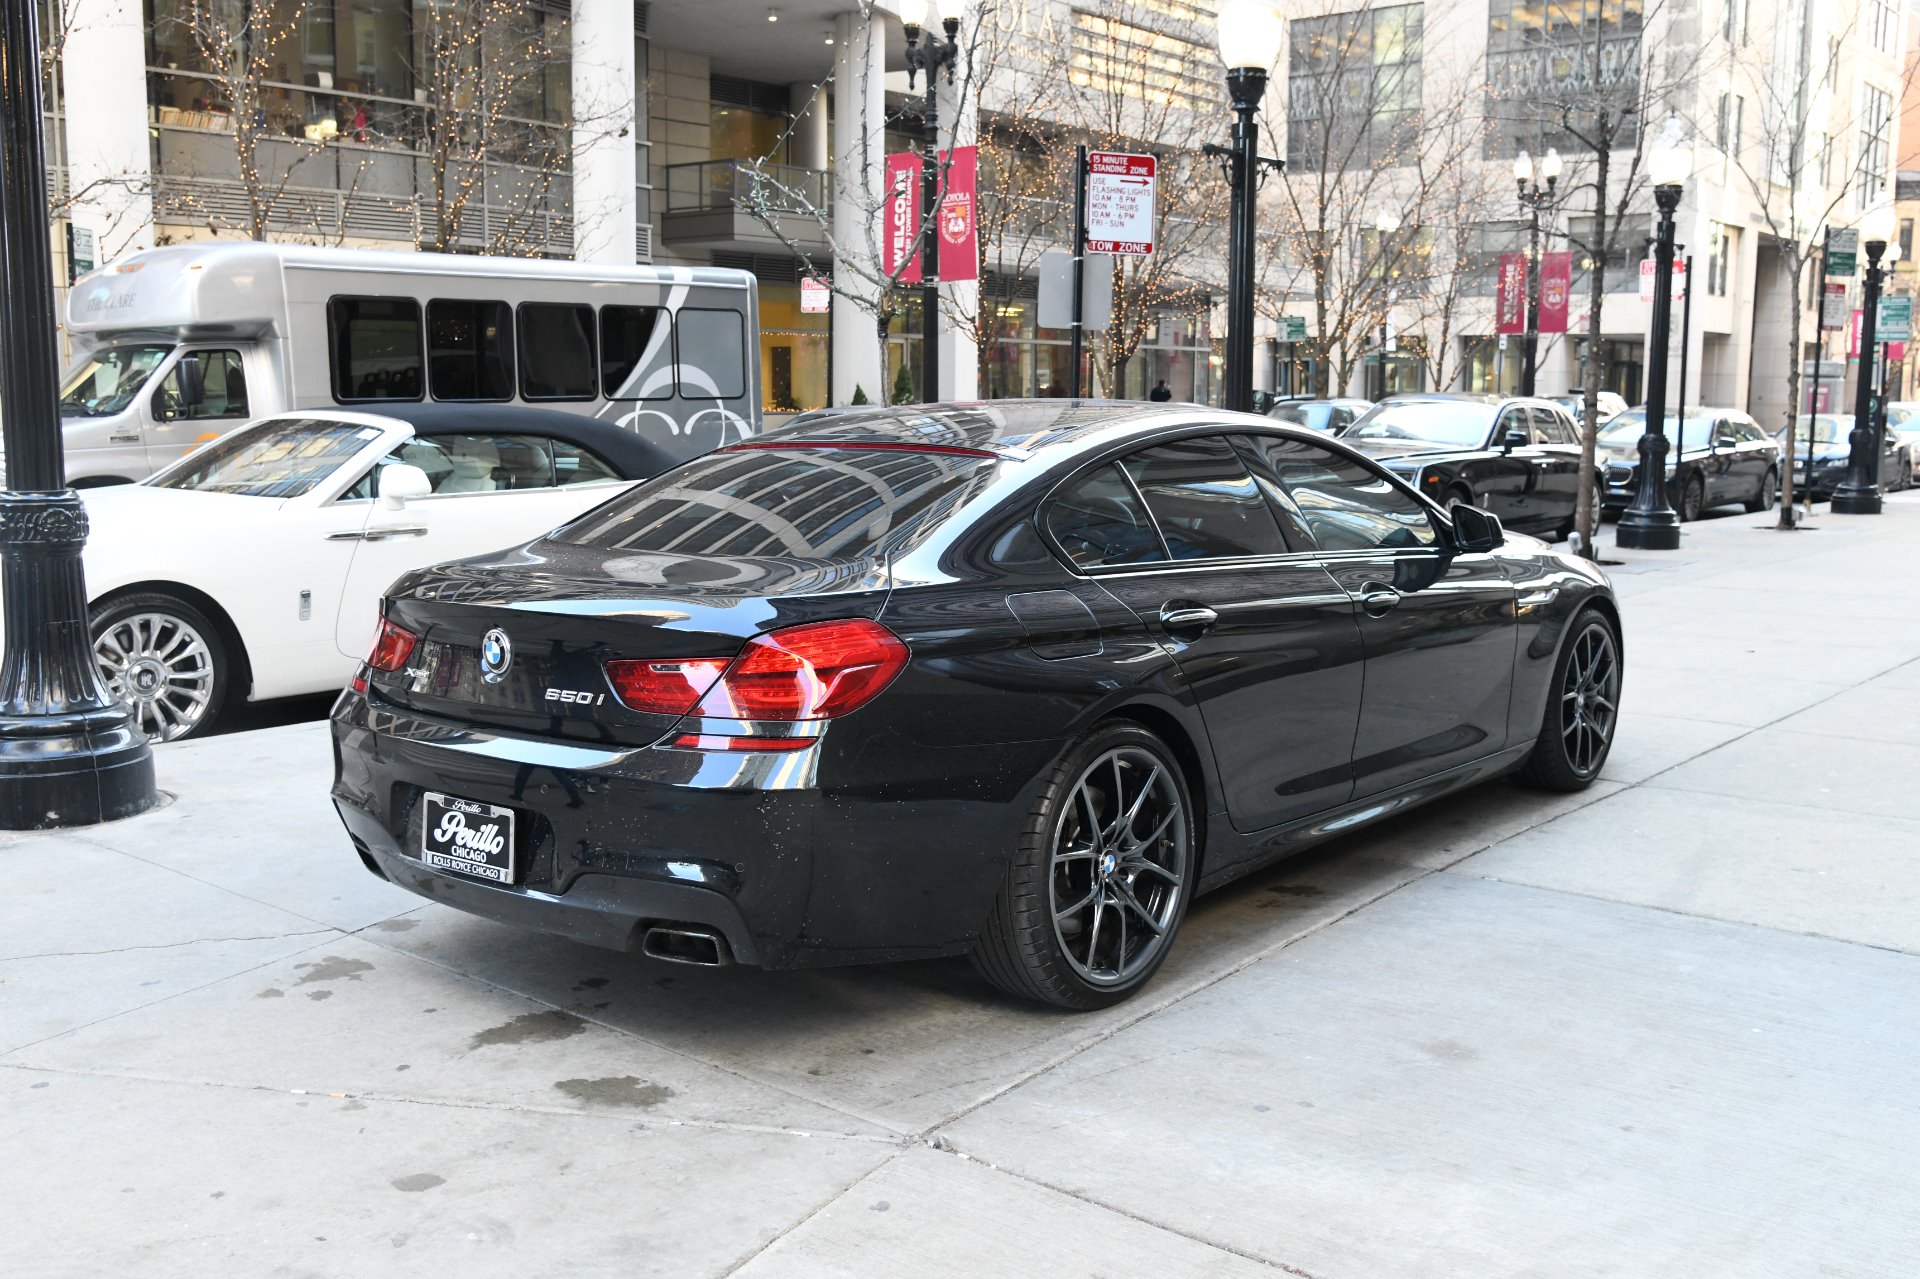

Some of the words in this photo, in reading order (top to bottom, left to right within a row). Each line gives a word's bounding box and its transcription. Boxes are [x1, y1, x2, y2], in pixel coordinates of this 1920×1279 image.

[1102, 156, 1128, 165] MINUTE
[1093, 164, 1127, 174] STANDING
[1130, 166, 1148, 175] ZONE
[943, 192, 970, 203] OYOLA
[1092, 186, 1126, 195] FLASHING
[1127, 188, 1151, 196] LIGHTS
[894, 170, 906, 267] WELCOME
[1091, 241, 1113, 251] TOW
[1119, 242, 1147, 253] ZONE
[104, 293, 136, 310] CLARE
[452, 800, 482, 813] Perillo
[434, 811, 504, 854] Perillo
[451, 846, 486, 862] CHICAGO
[433, 856, 450, 867] ROLLS
[452, 860, 471, 872] ROYCE
[472, 864, 499, 878] CHICAGO
